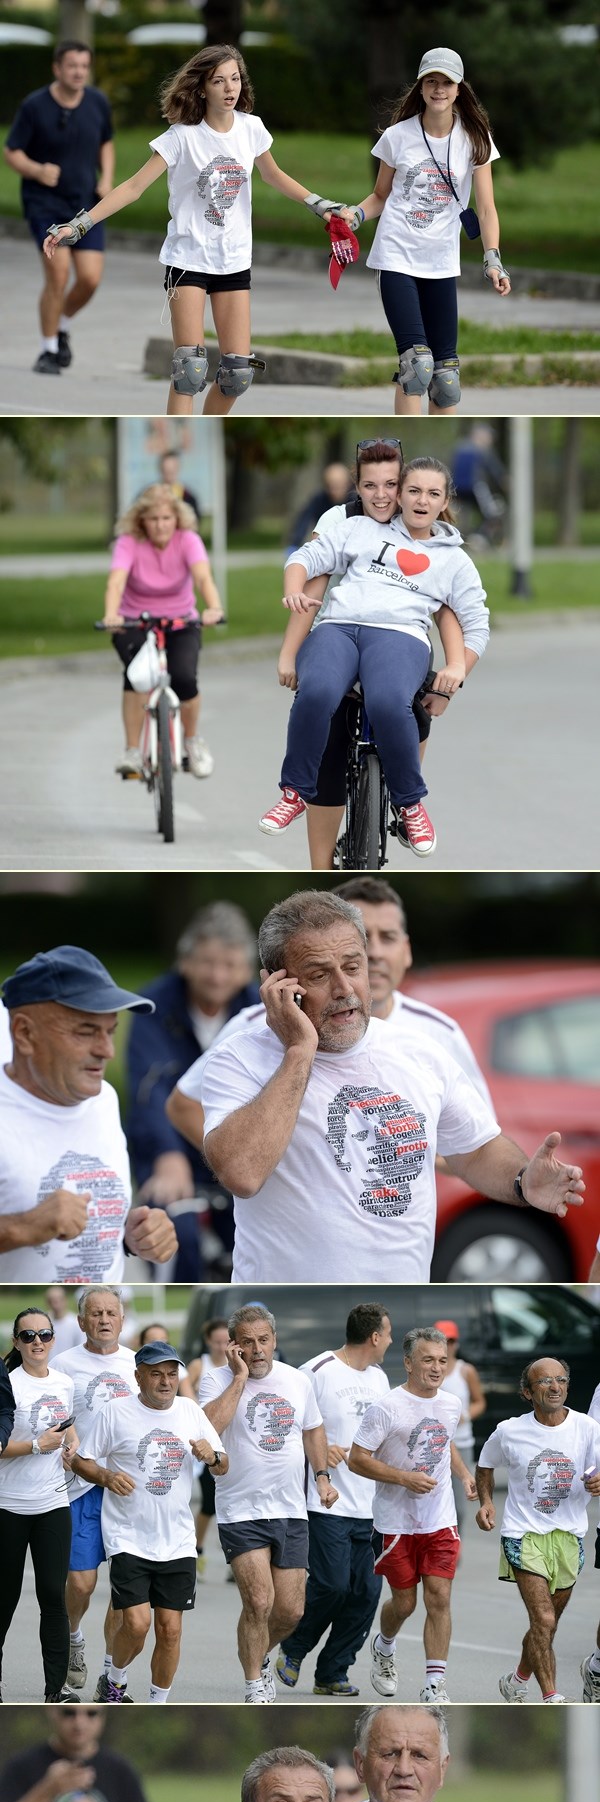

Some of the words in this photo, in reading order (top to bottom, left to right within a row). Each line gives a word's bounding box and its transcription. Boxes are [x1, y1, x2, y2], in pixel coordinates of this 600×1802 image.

[372, 541, 395, 566] I
[367, 564, 419, 591] Barcelona
[386, 1111, 407, 1121] belief
[380, 1128, 386, 1136] u
[388, 1122, 419, 1135] borbu
[392, 1128, 426, 1140] together
[366, 1141, 399, 1152] sacrifice
[396, 1141, 428, 1156] protiv
[76, 1180, 116, 1190] working
[372, 1187, 399, 1198] raka
[379, 1193, 412, 1204] cancer
